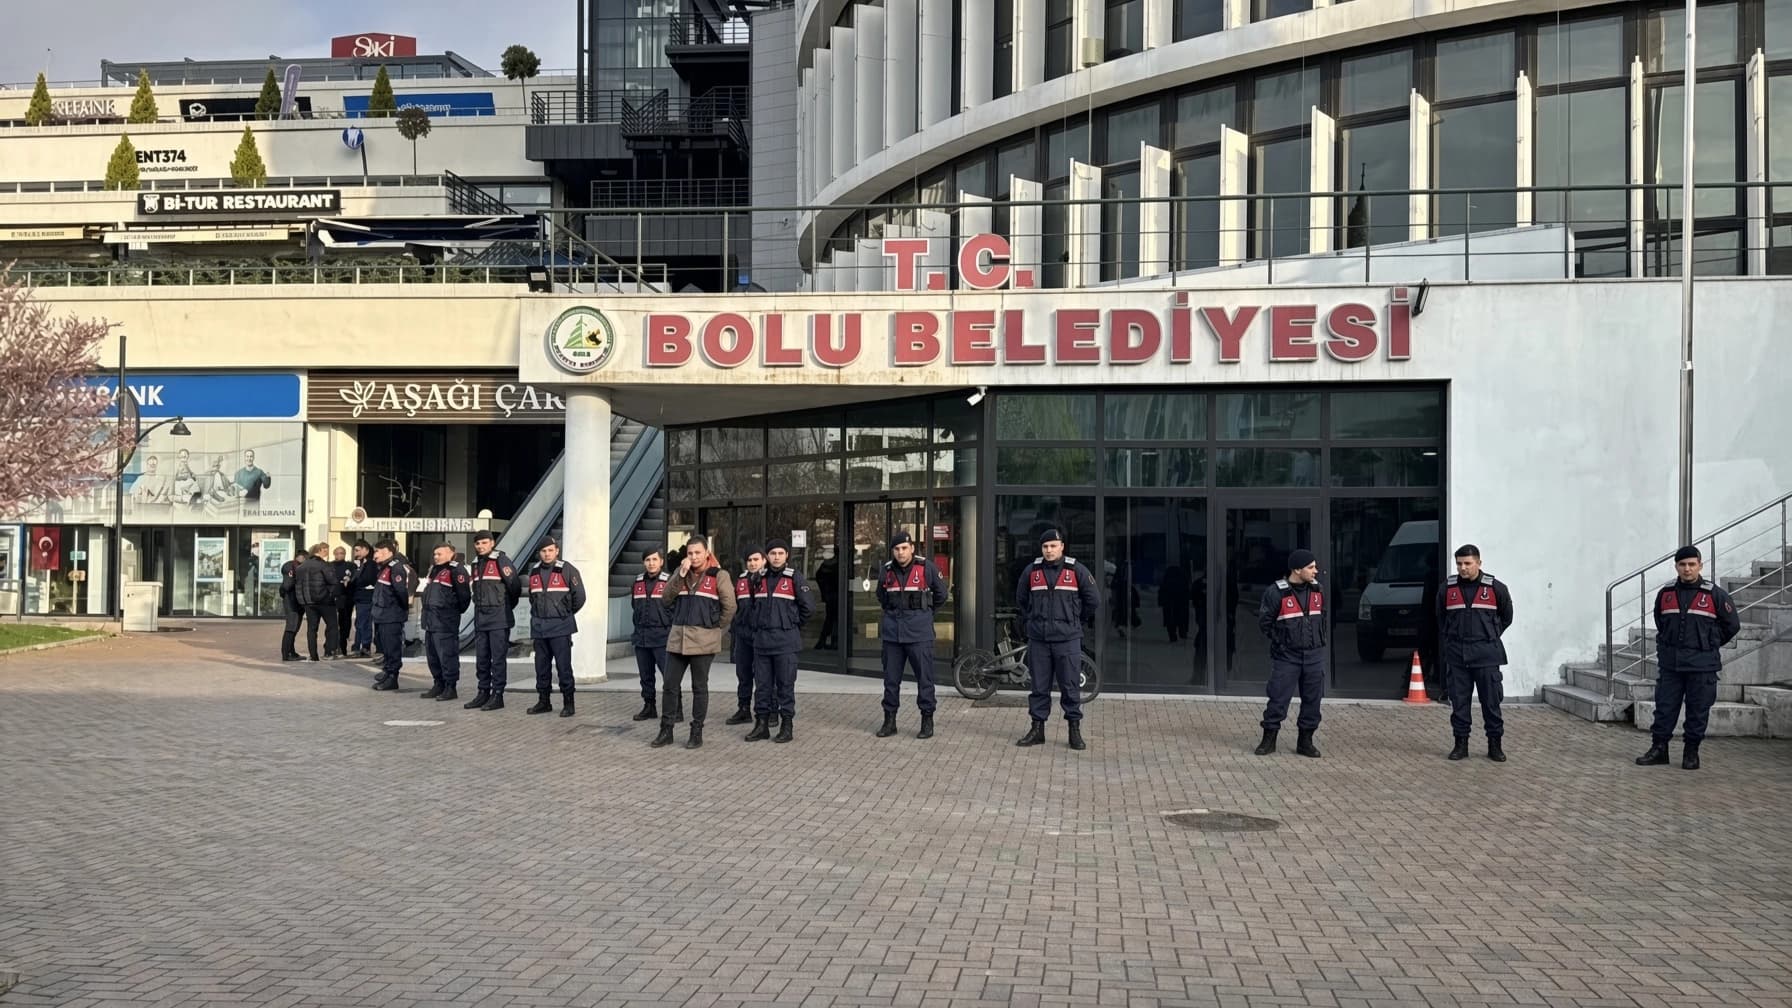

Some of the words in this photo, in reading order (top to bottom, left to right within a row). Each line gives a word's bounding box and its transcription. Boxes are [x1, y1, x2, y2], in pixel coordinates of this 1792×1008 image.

[223, 194, 334, 210] RESTAURANT
[646, 312, 863, 368] BOLU
[894, 286, 1412, 366] BELEDİYESİ
[377, 379, 482, 417] AŞAĞI
